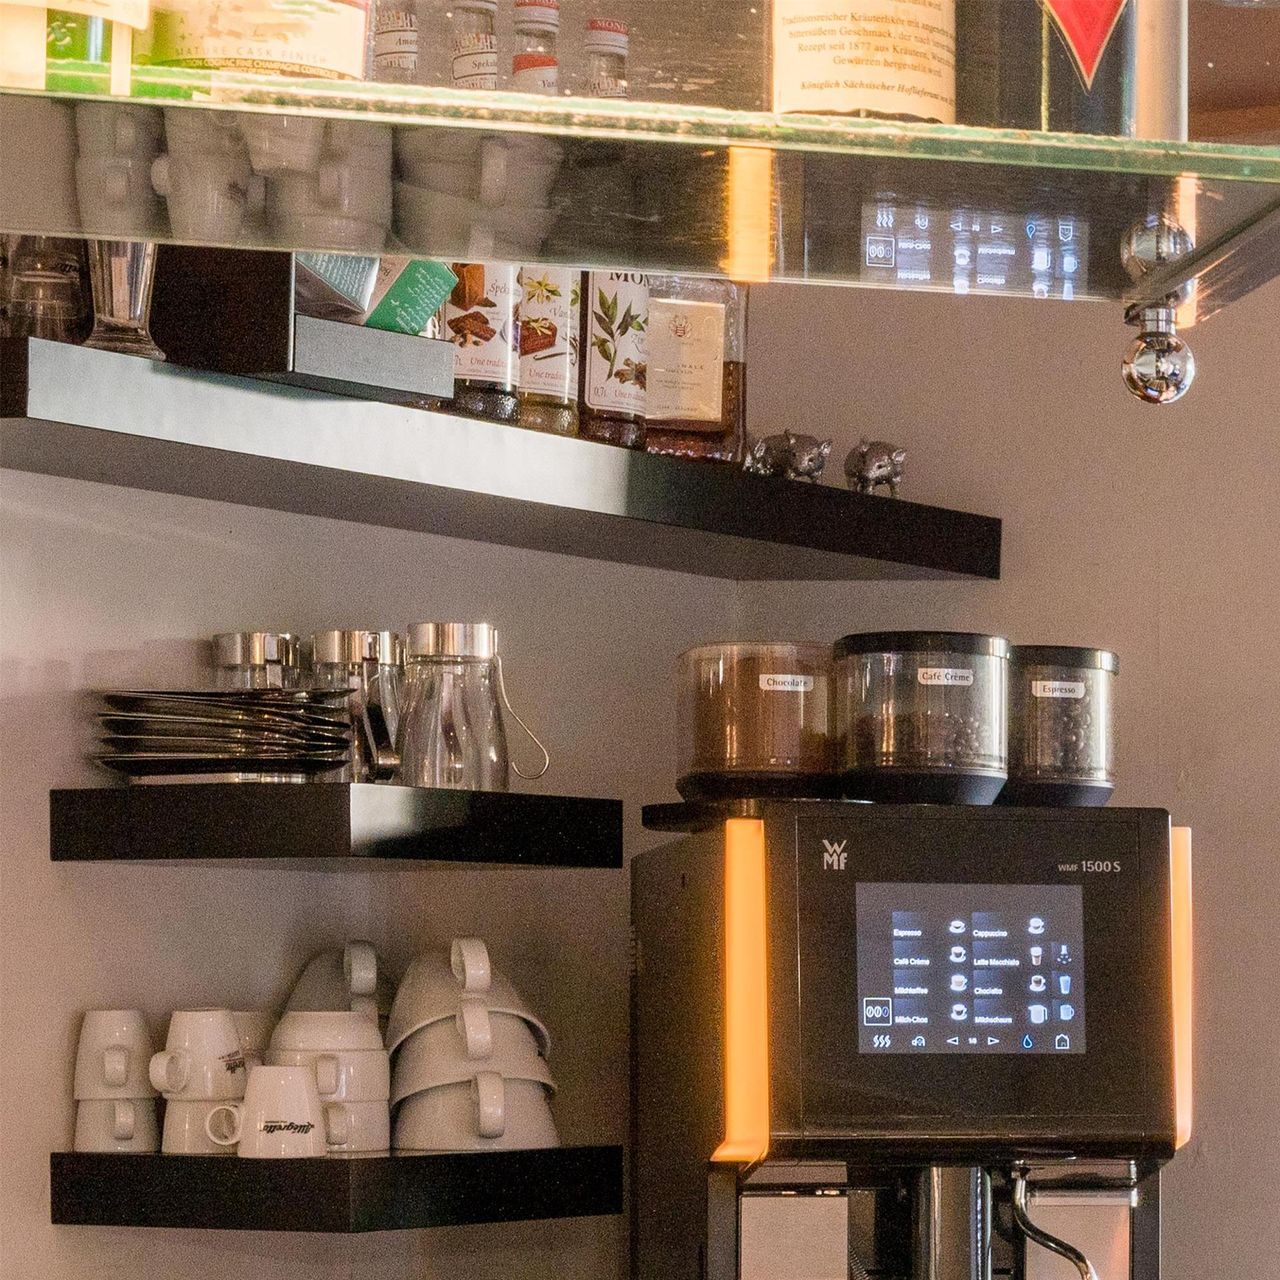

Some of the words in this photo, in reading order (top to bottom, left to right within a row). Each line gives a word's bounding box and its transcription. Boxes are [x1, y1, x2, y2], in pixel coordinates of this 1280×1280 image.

[839, 26, 896, 39] Geschmack,
[798, 42, 827, 53] Rezept
[848, 42, 872, 51] 1877
[833, 55, 881, 66] Gewürzen
[800, 80, 841, 91] Königlich
[843, 79, 896, 92] Sächsischer
[766, 677, 809, 688] Chocolate
[922, 671, 941, 682] Café
[944, 672, 970, 683] Crème
[1042, 684, 1076, 696] Espresso
[1058, 864, 1079, 873] WMF
[893, 929, 922, 938] Espresso
[973, 929, 1008, 939] Cappuccino
[894, 957, 909, 966] Café
